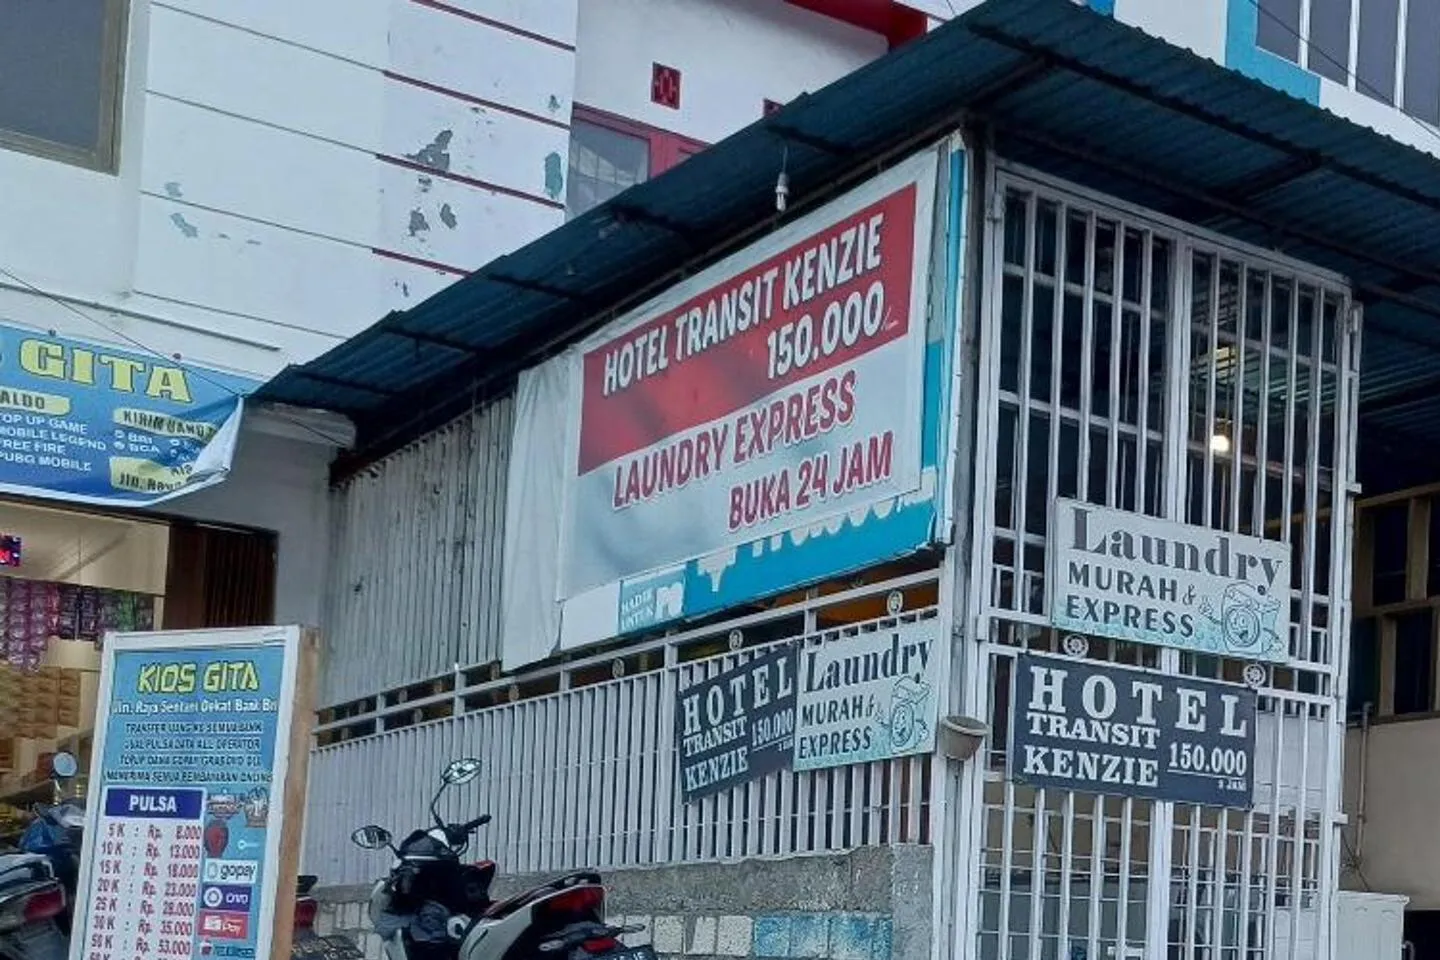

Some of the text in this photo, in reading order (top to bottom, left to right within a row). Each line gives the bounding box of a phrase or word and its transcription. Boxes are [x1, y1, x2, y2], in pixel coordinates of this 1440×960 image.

[602, 212, 884, 397] HOTEL TRANSIT KENZIE
[20, 337, 192, 403] GITA
[0, 390, 45, 409] ALDO
[0, 413, 22, 424] OP
[49, 418, 89, 435] GAME
[51, 431, 107, 450] LEGEND
[612, 370, 858, 509] LAUNDRY EXPRESS
[0, 439, 31, 452] REE
[39, 456, 92, 471] MOBILE
[728, 430, 895, 532] BUKA 24 JAM
[1072, 506, 1283, 596] Laundry
[1068, 561, 1178, 602] MURAH
[1066, 595, 1194, 638] EXPRESS
[137, 660, 260, 693] KIOS GITA
[803, 633, 934, 694] Laundry
[682, 657, 793, 736] HOTEL
[801, 695, 863, 727] MURAH
[1028, 665, 1247, 738] HOTEL
[683, 715, 748, 757] TRANSIT
[800, 726, 872, 760] EXPRESS
[1027, 711, 1160, 750] TRANSIT
[685, 747, 748, 792] KENZIE
[1023, 745, 1159, 788] KENZIE
[1168, 742, 1247, 776] 150.000
[129, 795, 177, 812] PULSA
[221, 865, 256, 882] gopay
